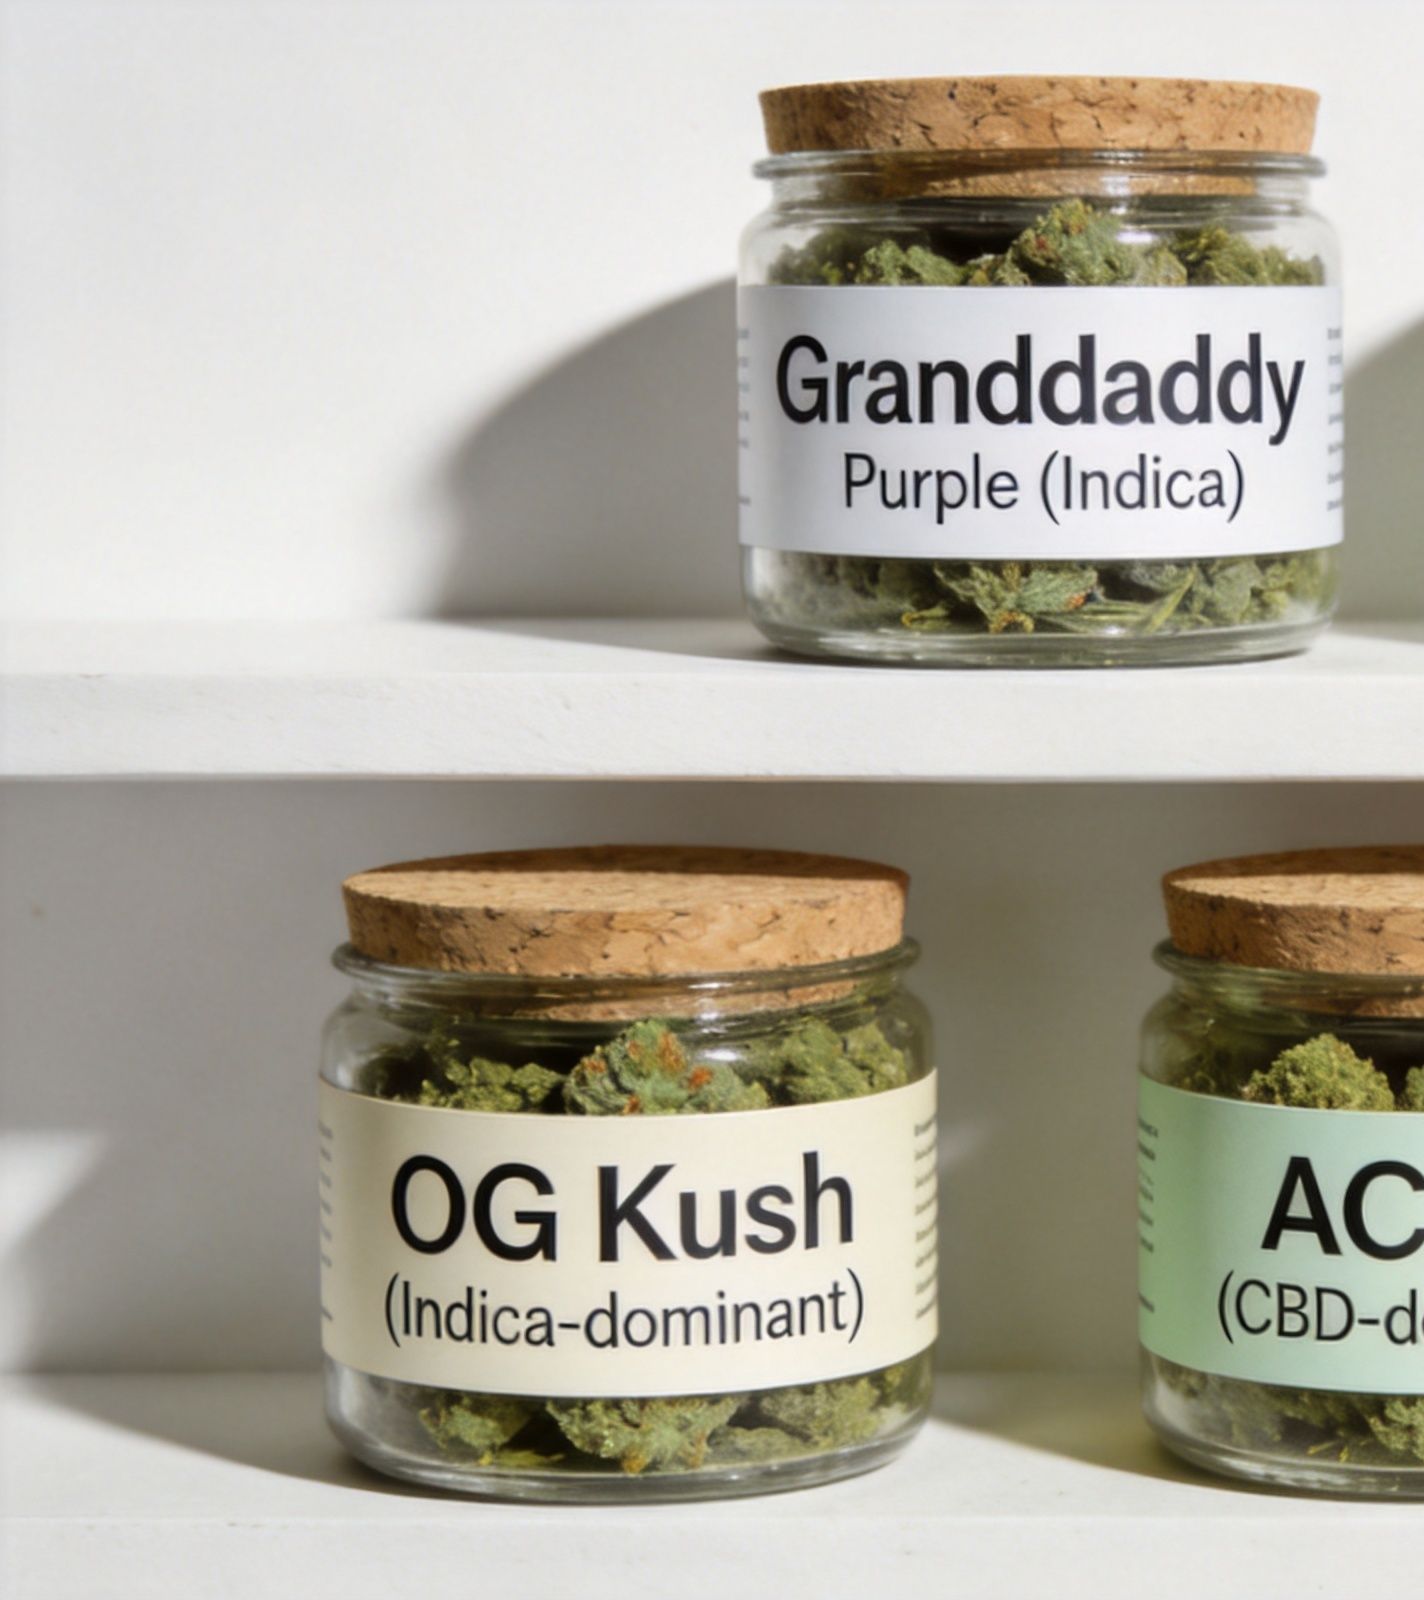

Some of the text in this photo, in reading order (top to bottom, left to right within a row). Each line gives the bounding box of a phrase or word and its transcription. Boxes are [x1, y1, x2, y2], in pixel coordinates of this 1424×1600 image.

[775, 332, 1305, 446] Granddaddy
[843, 449, 1244, 525] Purple (Indica)
[389, 1153, 557, 1263] OG
[598, 1151, 853, 1263] Kush
[384, 1268, 863, 1349] (Indica-dominant)
